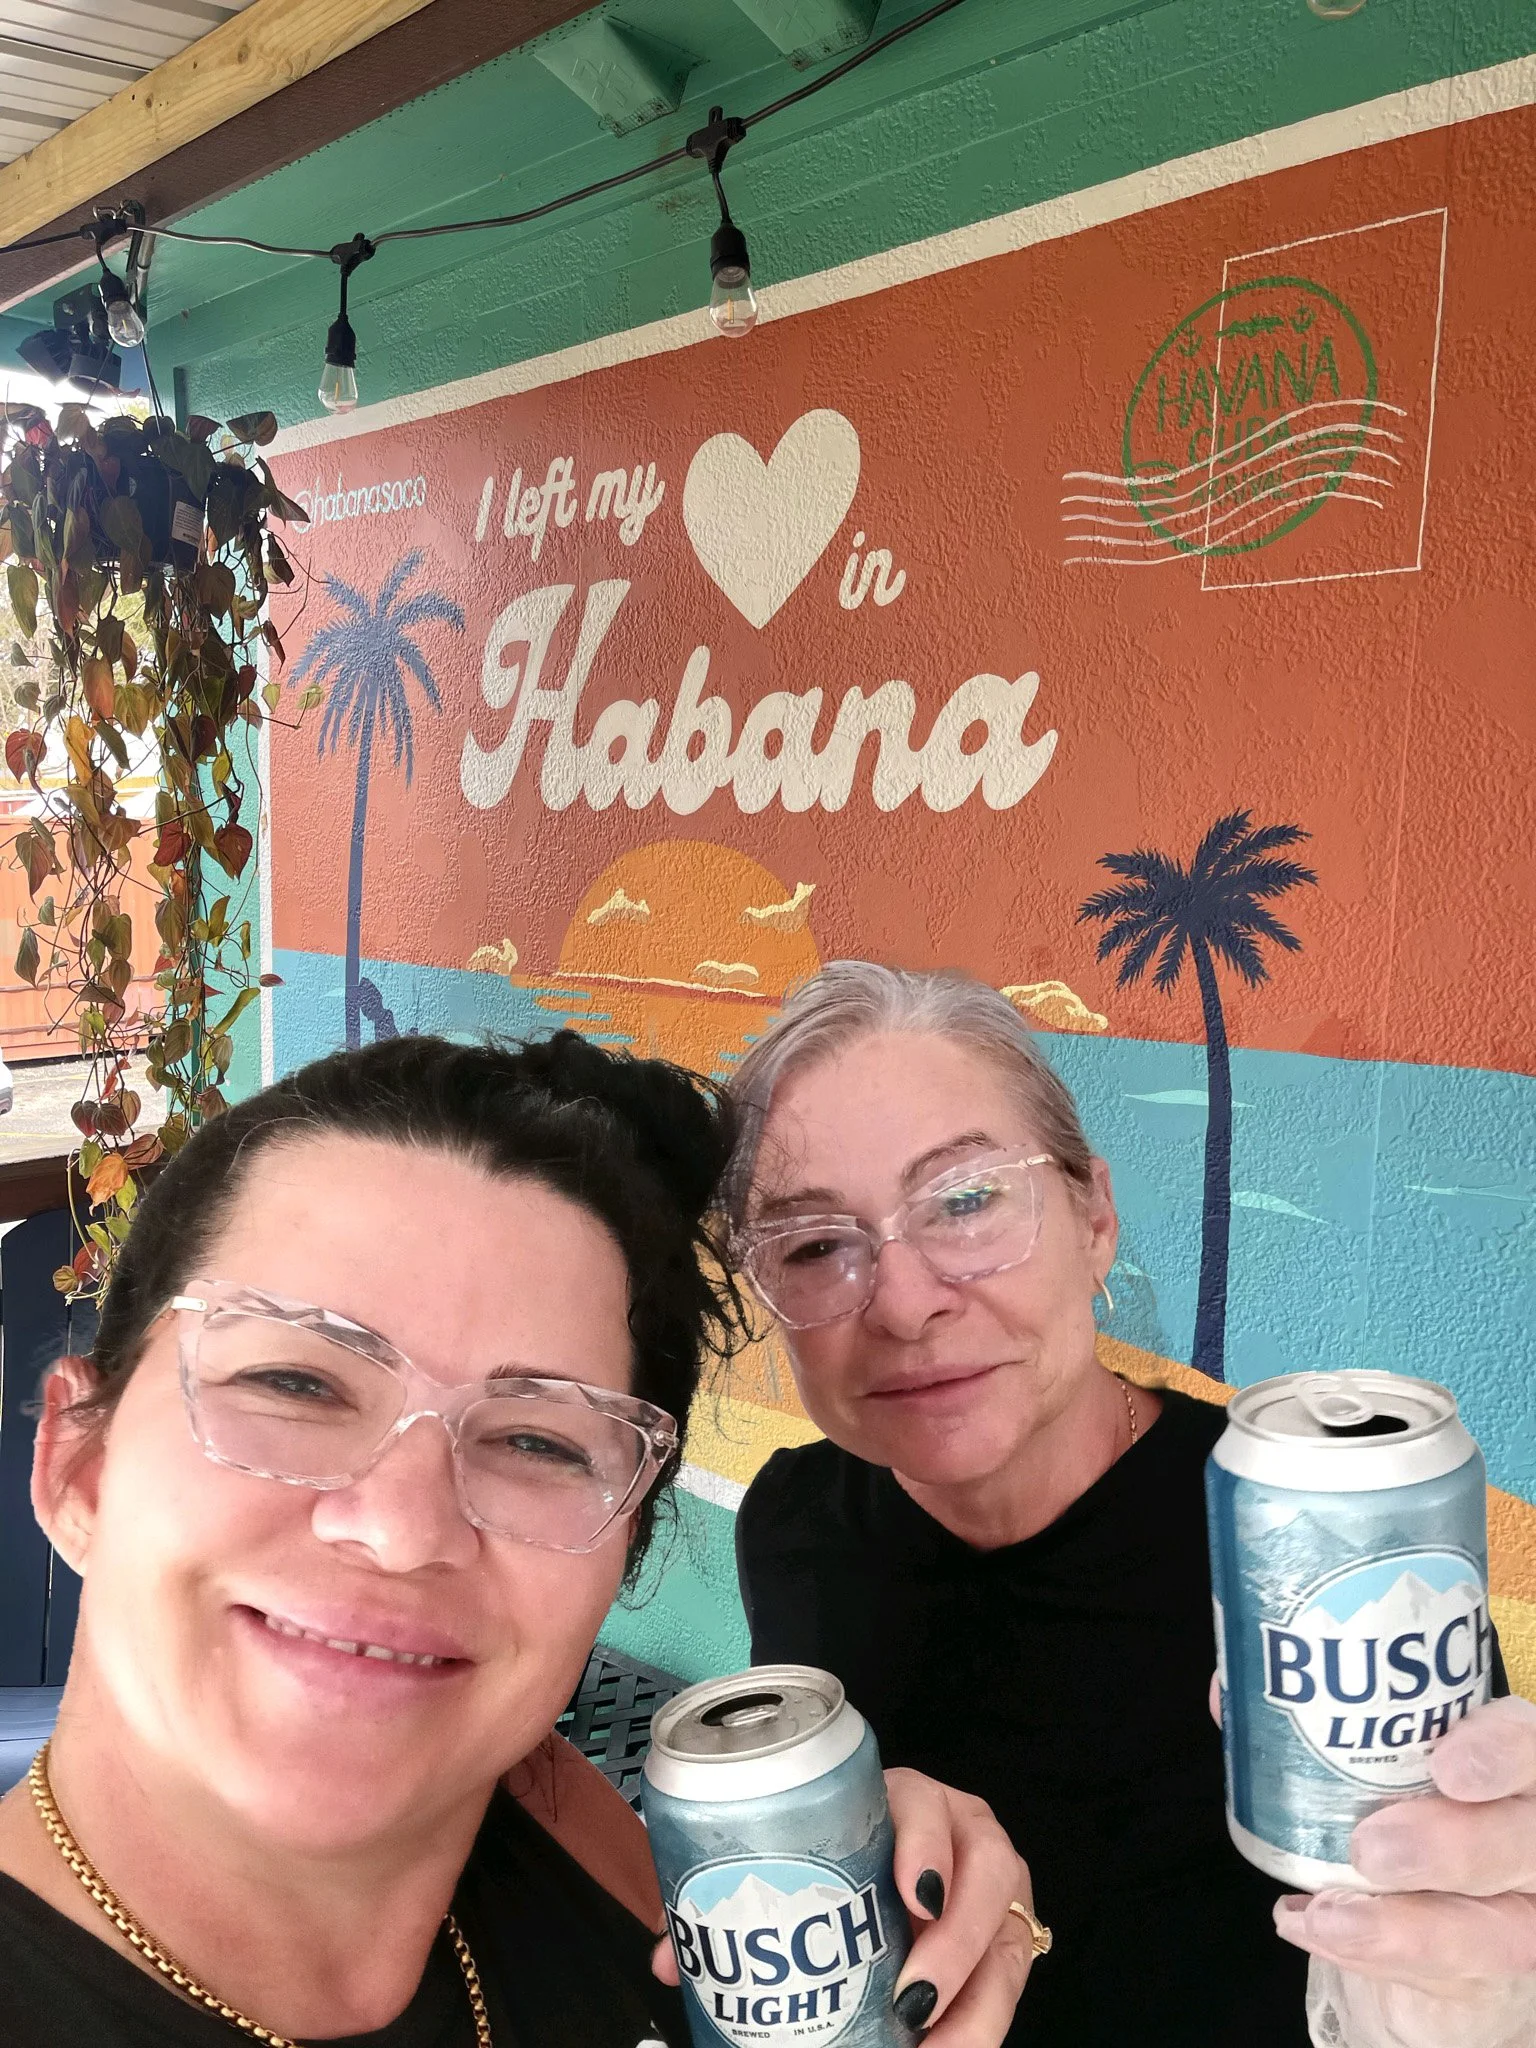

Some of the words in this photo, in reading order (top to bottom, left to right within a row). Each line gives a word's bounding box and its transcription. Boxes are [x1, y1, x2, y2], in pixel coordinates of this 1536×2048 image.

[1157, 336, 1340, 432] HAVANA
[1188, 412, 1294, 468] CUBA
[474, 476, 495, 542] I
[503, 456, 577, 562] left
[585, 461, 665, 546] my
[838, 531, 907, 610] in
[459, 578, 1058, 816] Habana
[669, 1887, 884, 1986] BUSCH
[713, 1978, 848, 2027] LIGHT
[732, 2028, 771, 2039] BREWED
[793, 2028, 805, 2036] IN
